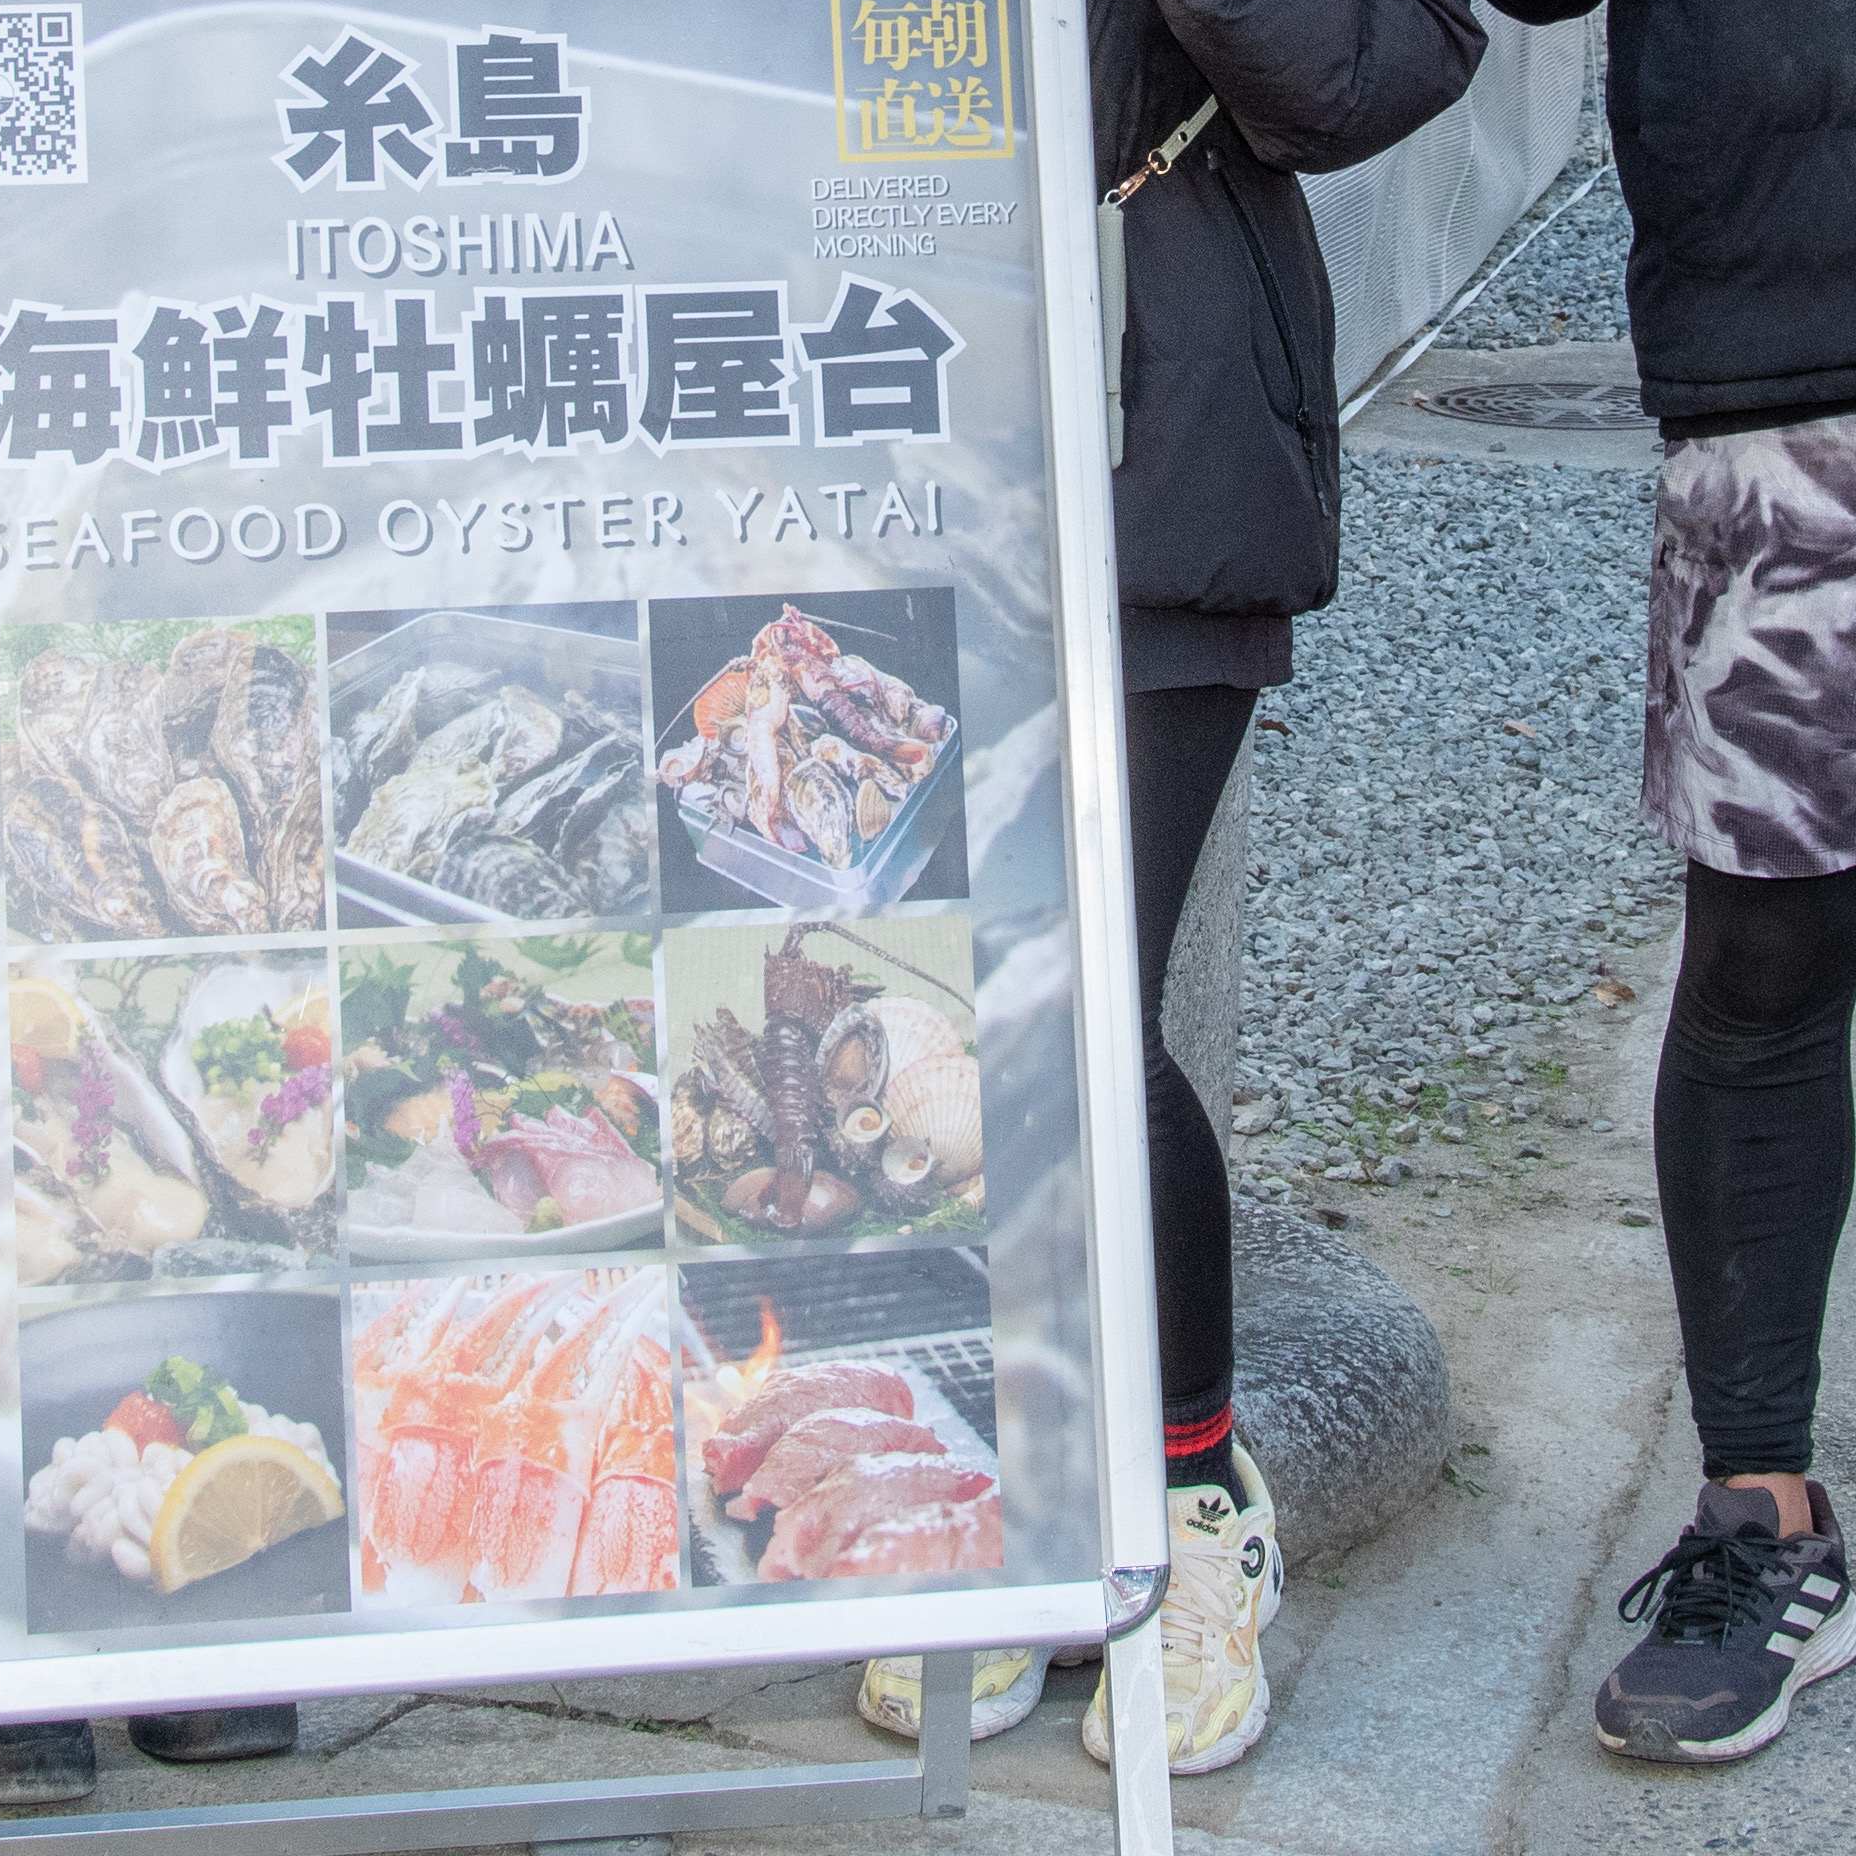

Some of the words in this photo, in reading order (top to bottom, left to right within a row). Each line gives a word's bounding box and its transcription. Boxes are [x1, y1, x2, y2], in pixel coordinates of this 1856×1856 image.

[270, 23, 591, 194] 糸島
[855, 75, 993, 151] 直送
[810, 174, 950, 202] DELIVERED
[811, 203, 933, 231] DIRECTLY
[936, 201, 1018, 226] EVERY
[287, 210, 634, 280] ITOSHIMA
[812, 232, 937, 260] MORNING
[376, 486, 686, 558] OYSTER
[714, 478, 946, 546] YATAI
[1186, 1518, 1220, 1536] adidas
